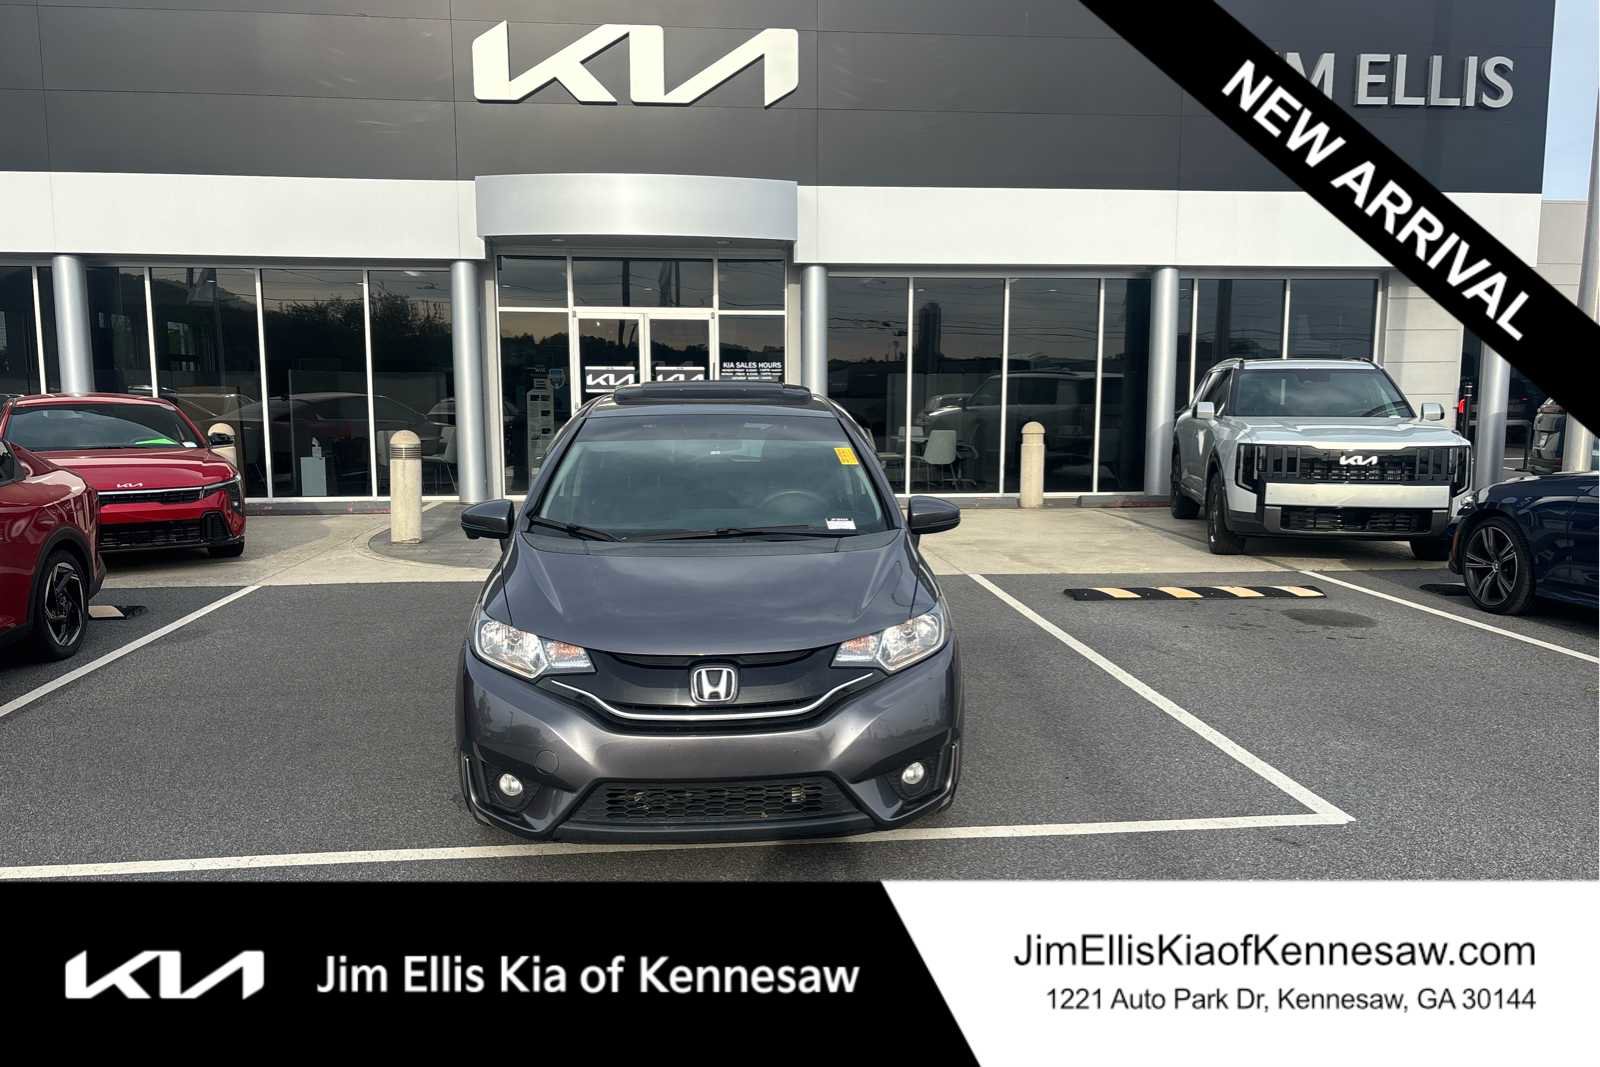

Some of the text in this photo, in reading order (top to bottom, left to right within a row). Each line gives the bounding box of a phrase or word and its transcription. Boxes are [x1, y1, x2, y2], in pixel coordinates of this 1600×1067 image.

[472, 20, 799, 107] KIA
[1354, 53, 1514, 108] ELLIS
[722, 361, 782, 369] KIA SALES HOURS
